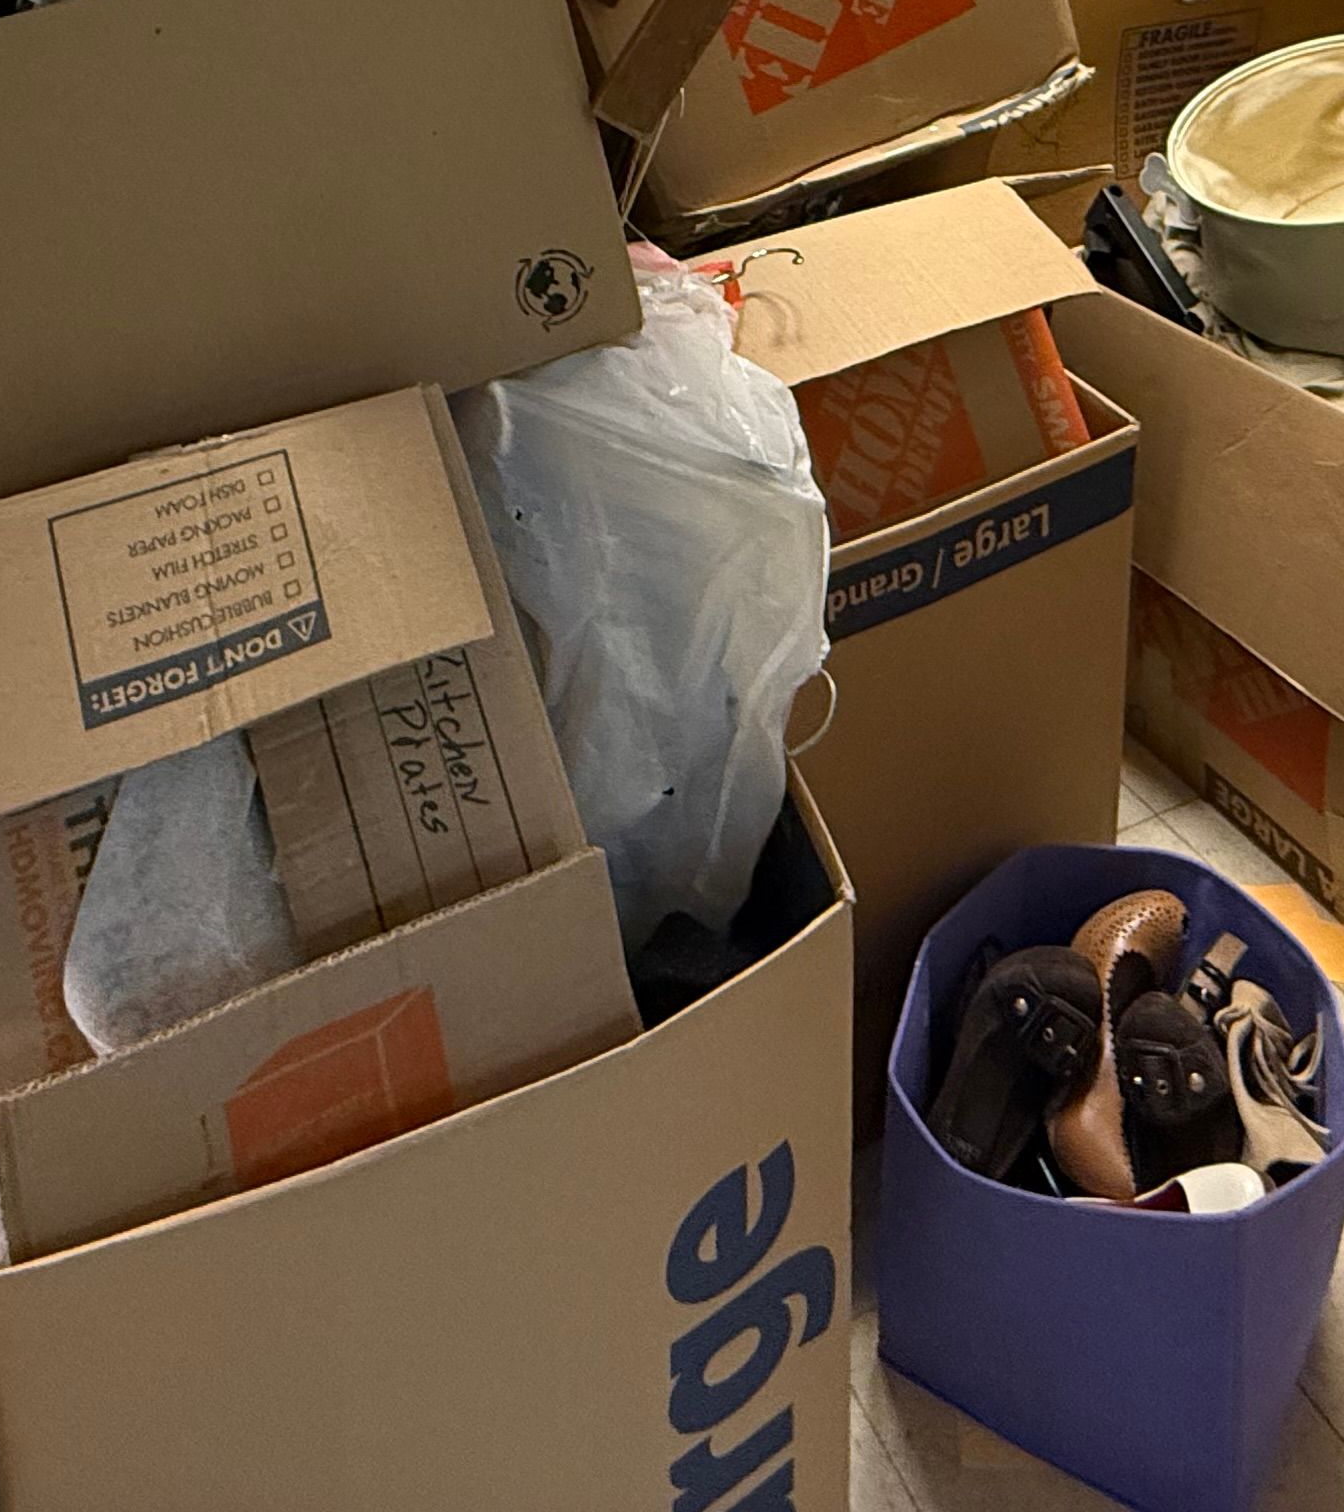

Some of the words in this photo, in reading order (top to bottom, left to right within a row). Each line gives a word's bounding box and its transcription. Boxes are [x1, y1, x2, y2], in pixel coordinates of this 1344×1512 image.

[1139, 20, 1213, 47] FRAGILE
[155, 493, 207, 518] FOAM
[209, 479, 246, 502] DISH
[180, 507, 252, 542] PACKING
[954, 504, 1050, 568] Large
[128, 530, 177, 557] PAPER
[194, 535, 259, 569] STRETCH
[151, 559, 189, 581] FILM
[196, 563, 264, 599] MOVING
[107, 590, 191, 628] BLANKETS
[216, 591, 273, 623] BUBBLE
[133, 612, 217, 652] CUSHION
[206, 629, 283, 676] DON'T
[90, 659, 200, 713] FORGET:
[380, 699, 448, 834] Plates
[1215, 782, 1310, 878] LARGE
